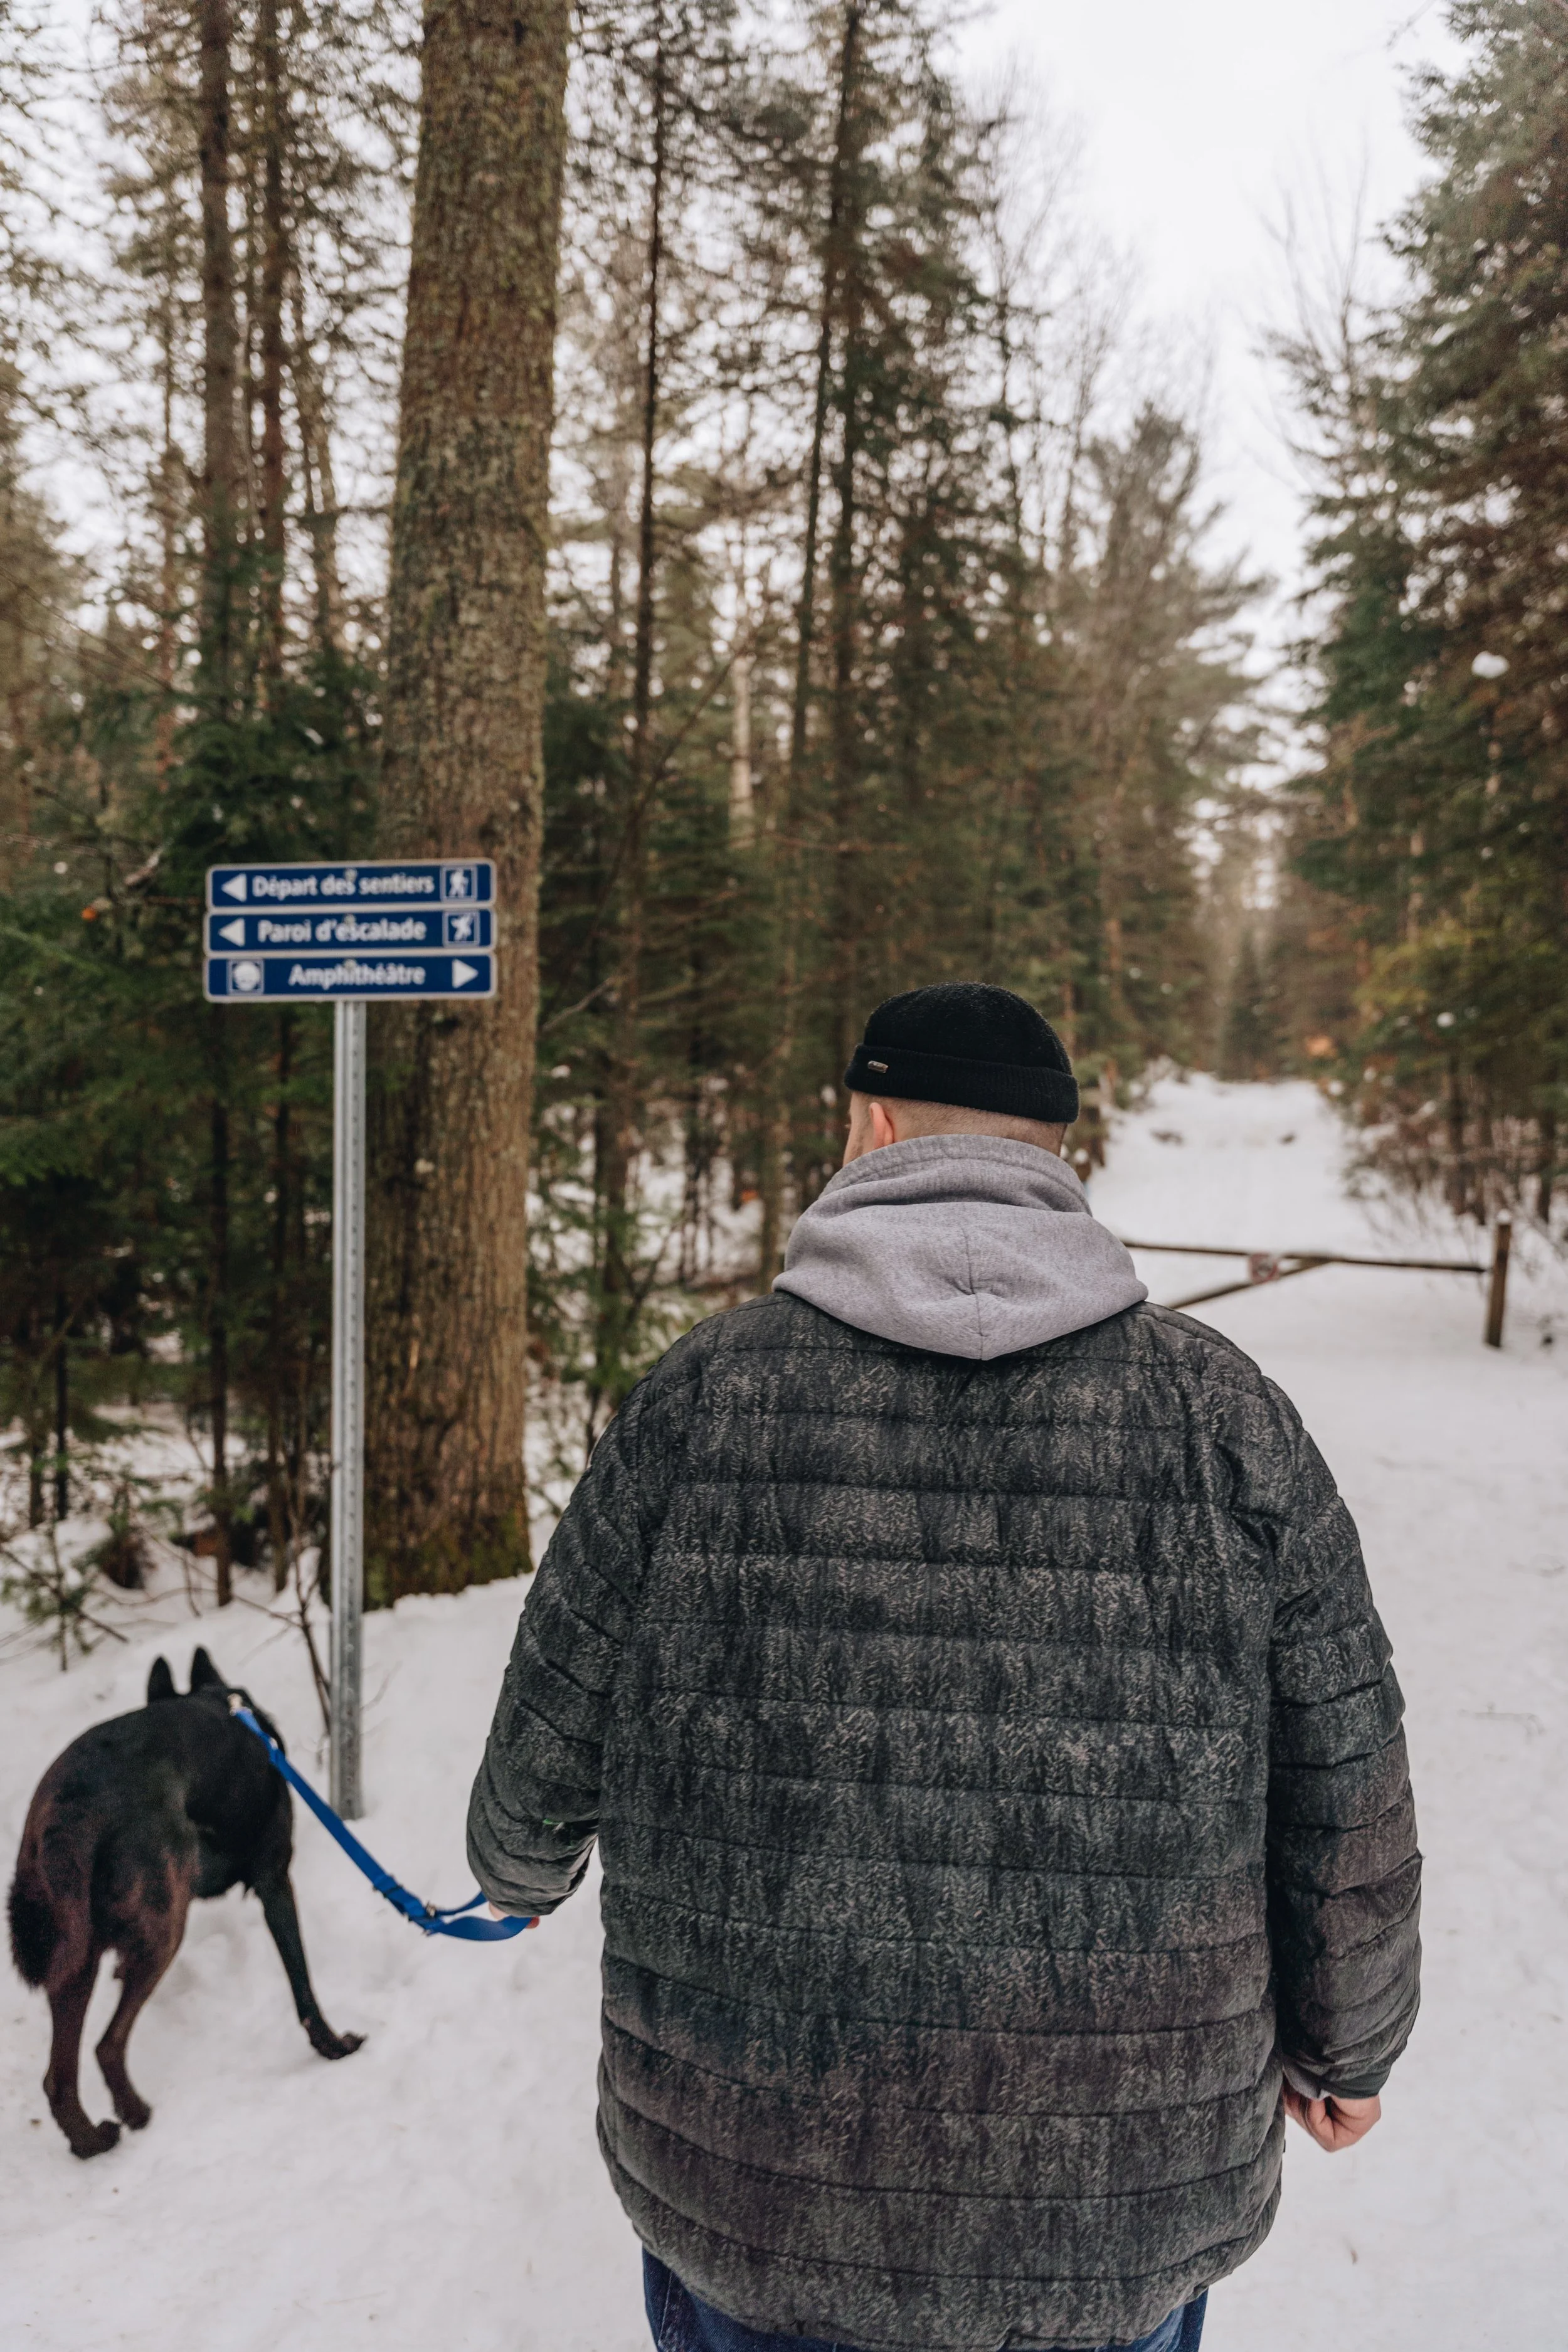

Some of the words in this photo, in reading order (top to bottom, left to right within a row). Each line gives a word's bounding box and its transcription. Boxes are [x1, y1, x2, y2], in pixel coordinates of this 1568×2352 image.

[252, 874, 318, 901] Départ
[320, 874, 356, 896] des
[359, 872, 434, 894] sentiers
[258, 919, 312, 943] Paroi
[315, 917, 427, 941] d'escalade
[289, 963, 426, 990] Amphithéâtre
